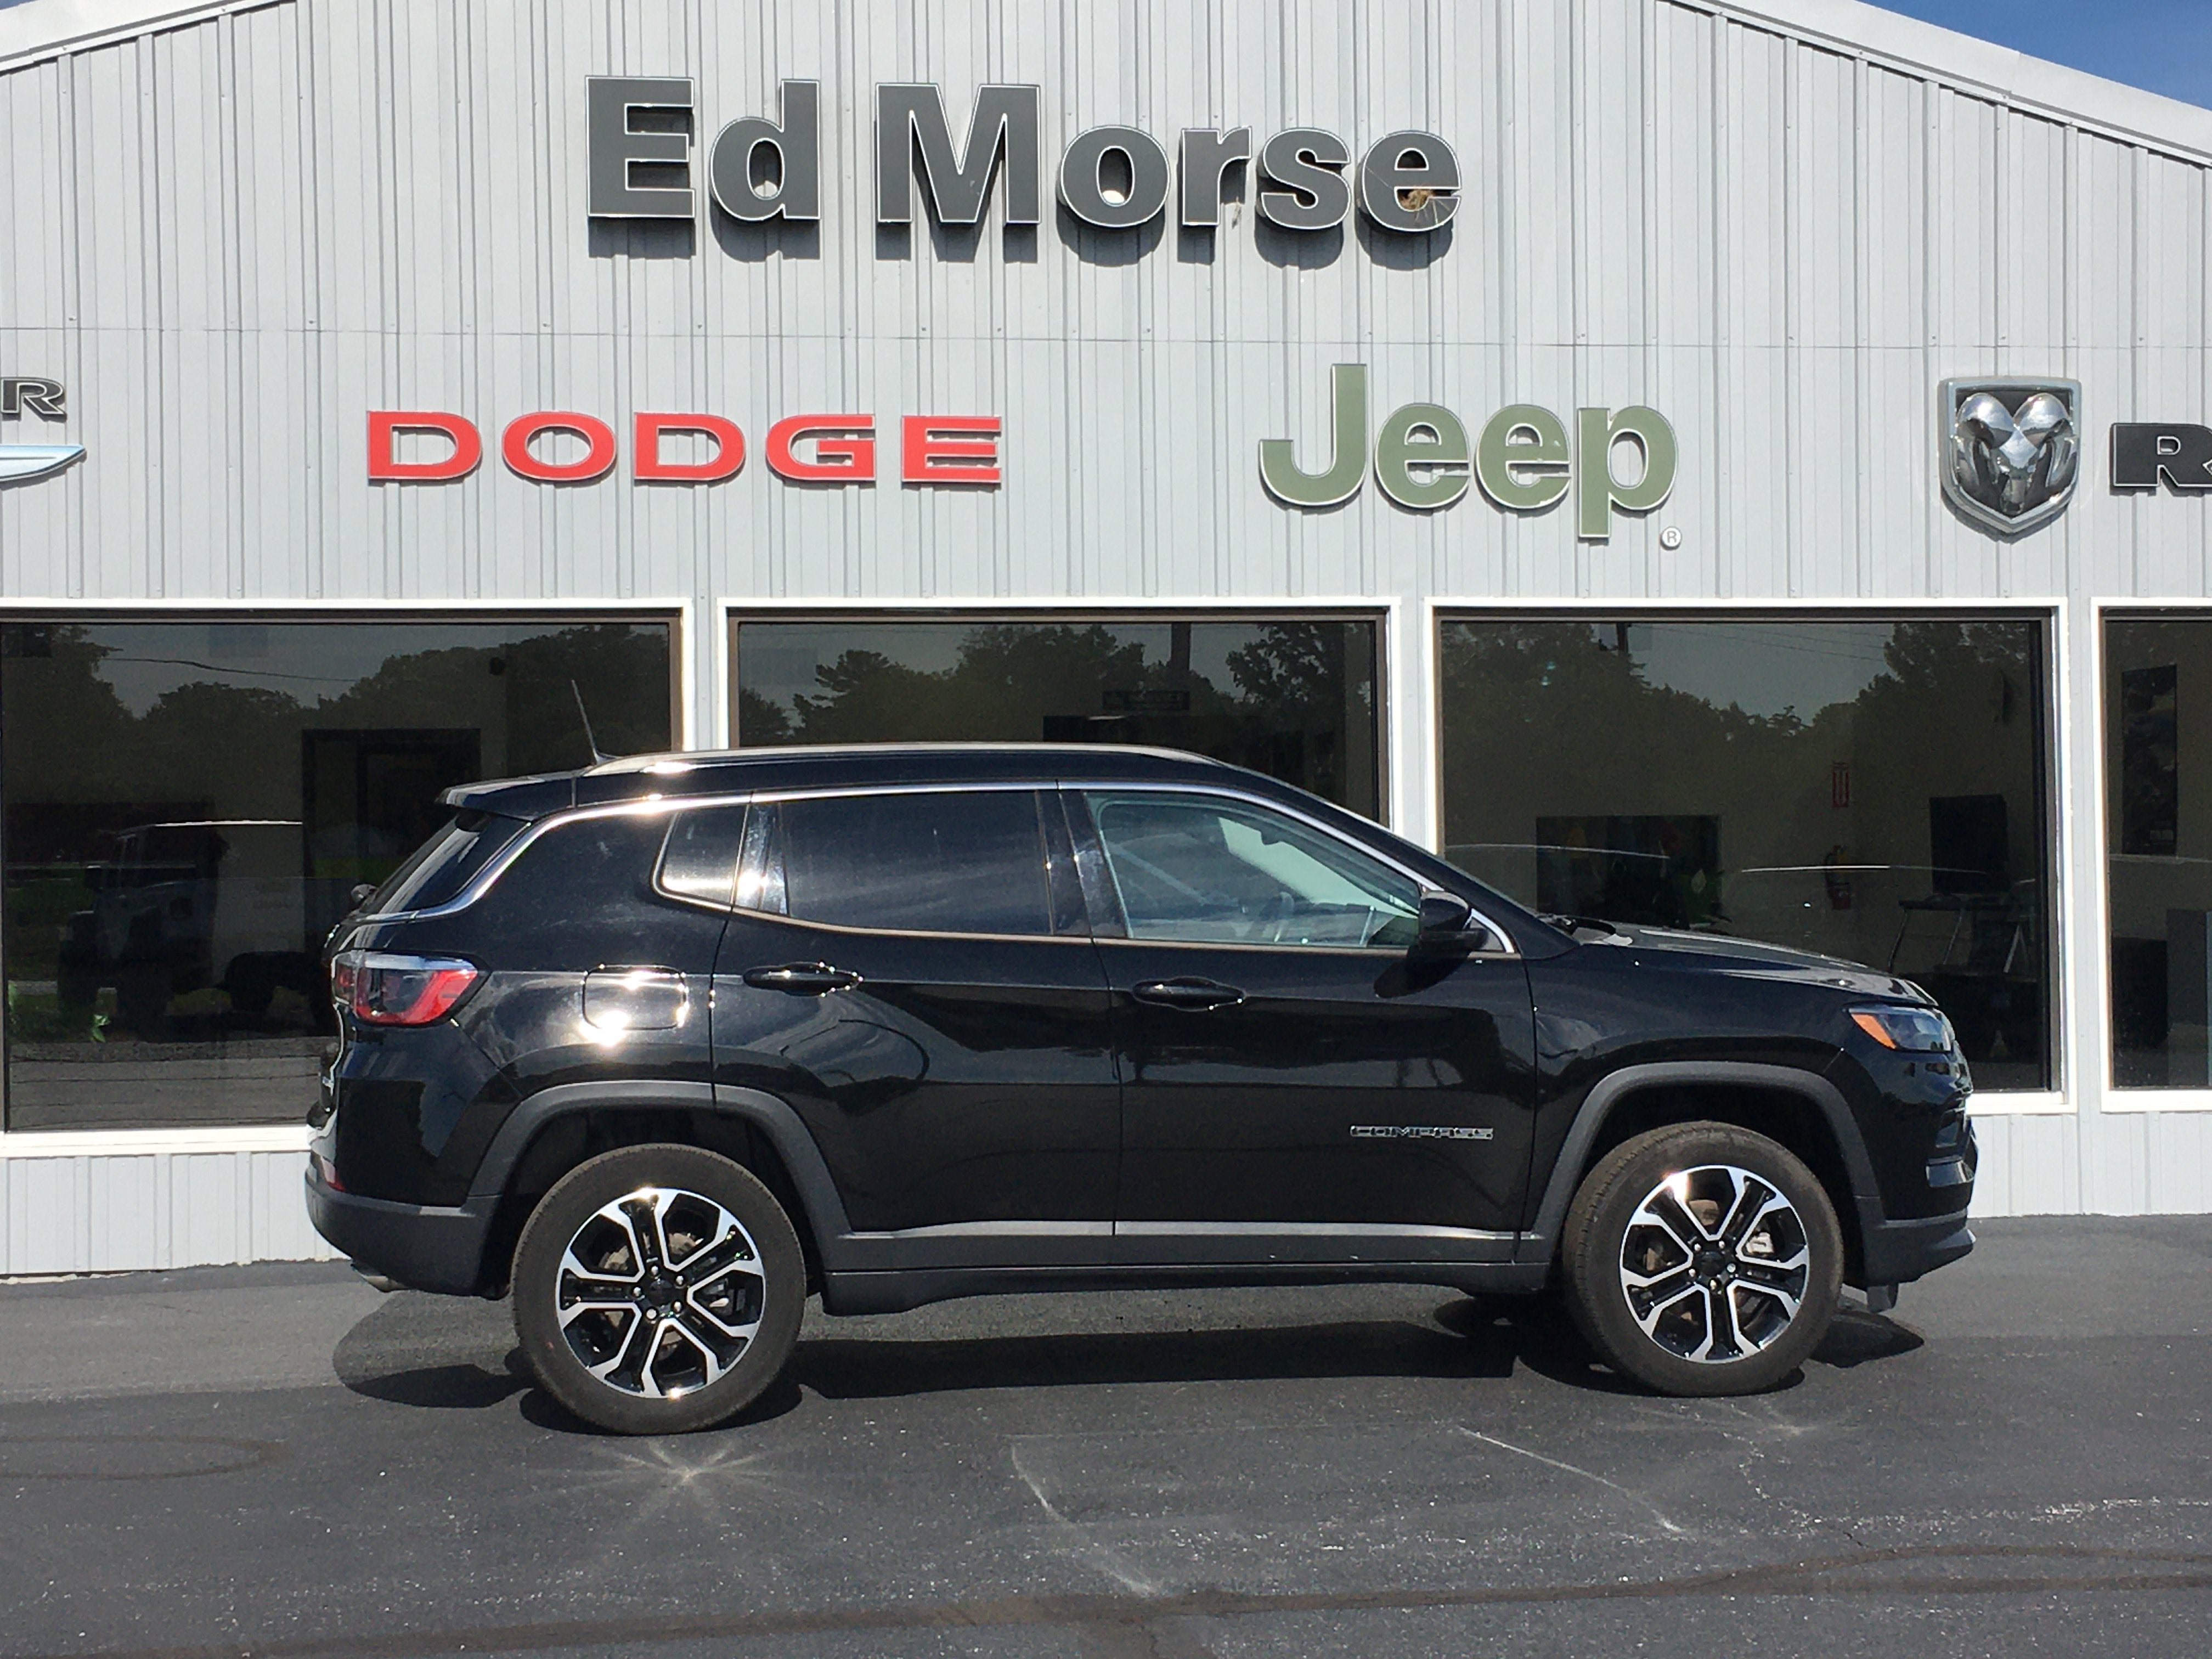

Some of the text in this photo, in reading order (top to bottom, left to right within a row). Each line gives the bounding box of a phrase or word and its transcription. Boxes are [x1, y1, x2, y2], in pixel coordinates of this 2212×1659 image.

[585, 76, 1462, 233] Ed Morse
[366, 410, 1002, 484] DODGE
[1259, 363, 1678, 539] Jeep
[1350, 1125, 1493, 1140] COMPASS
